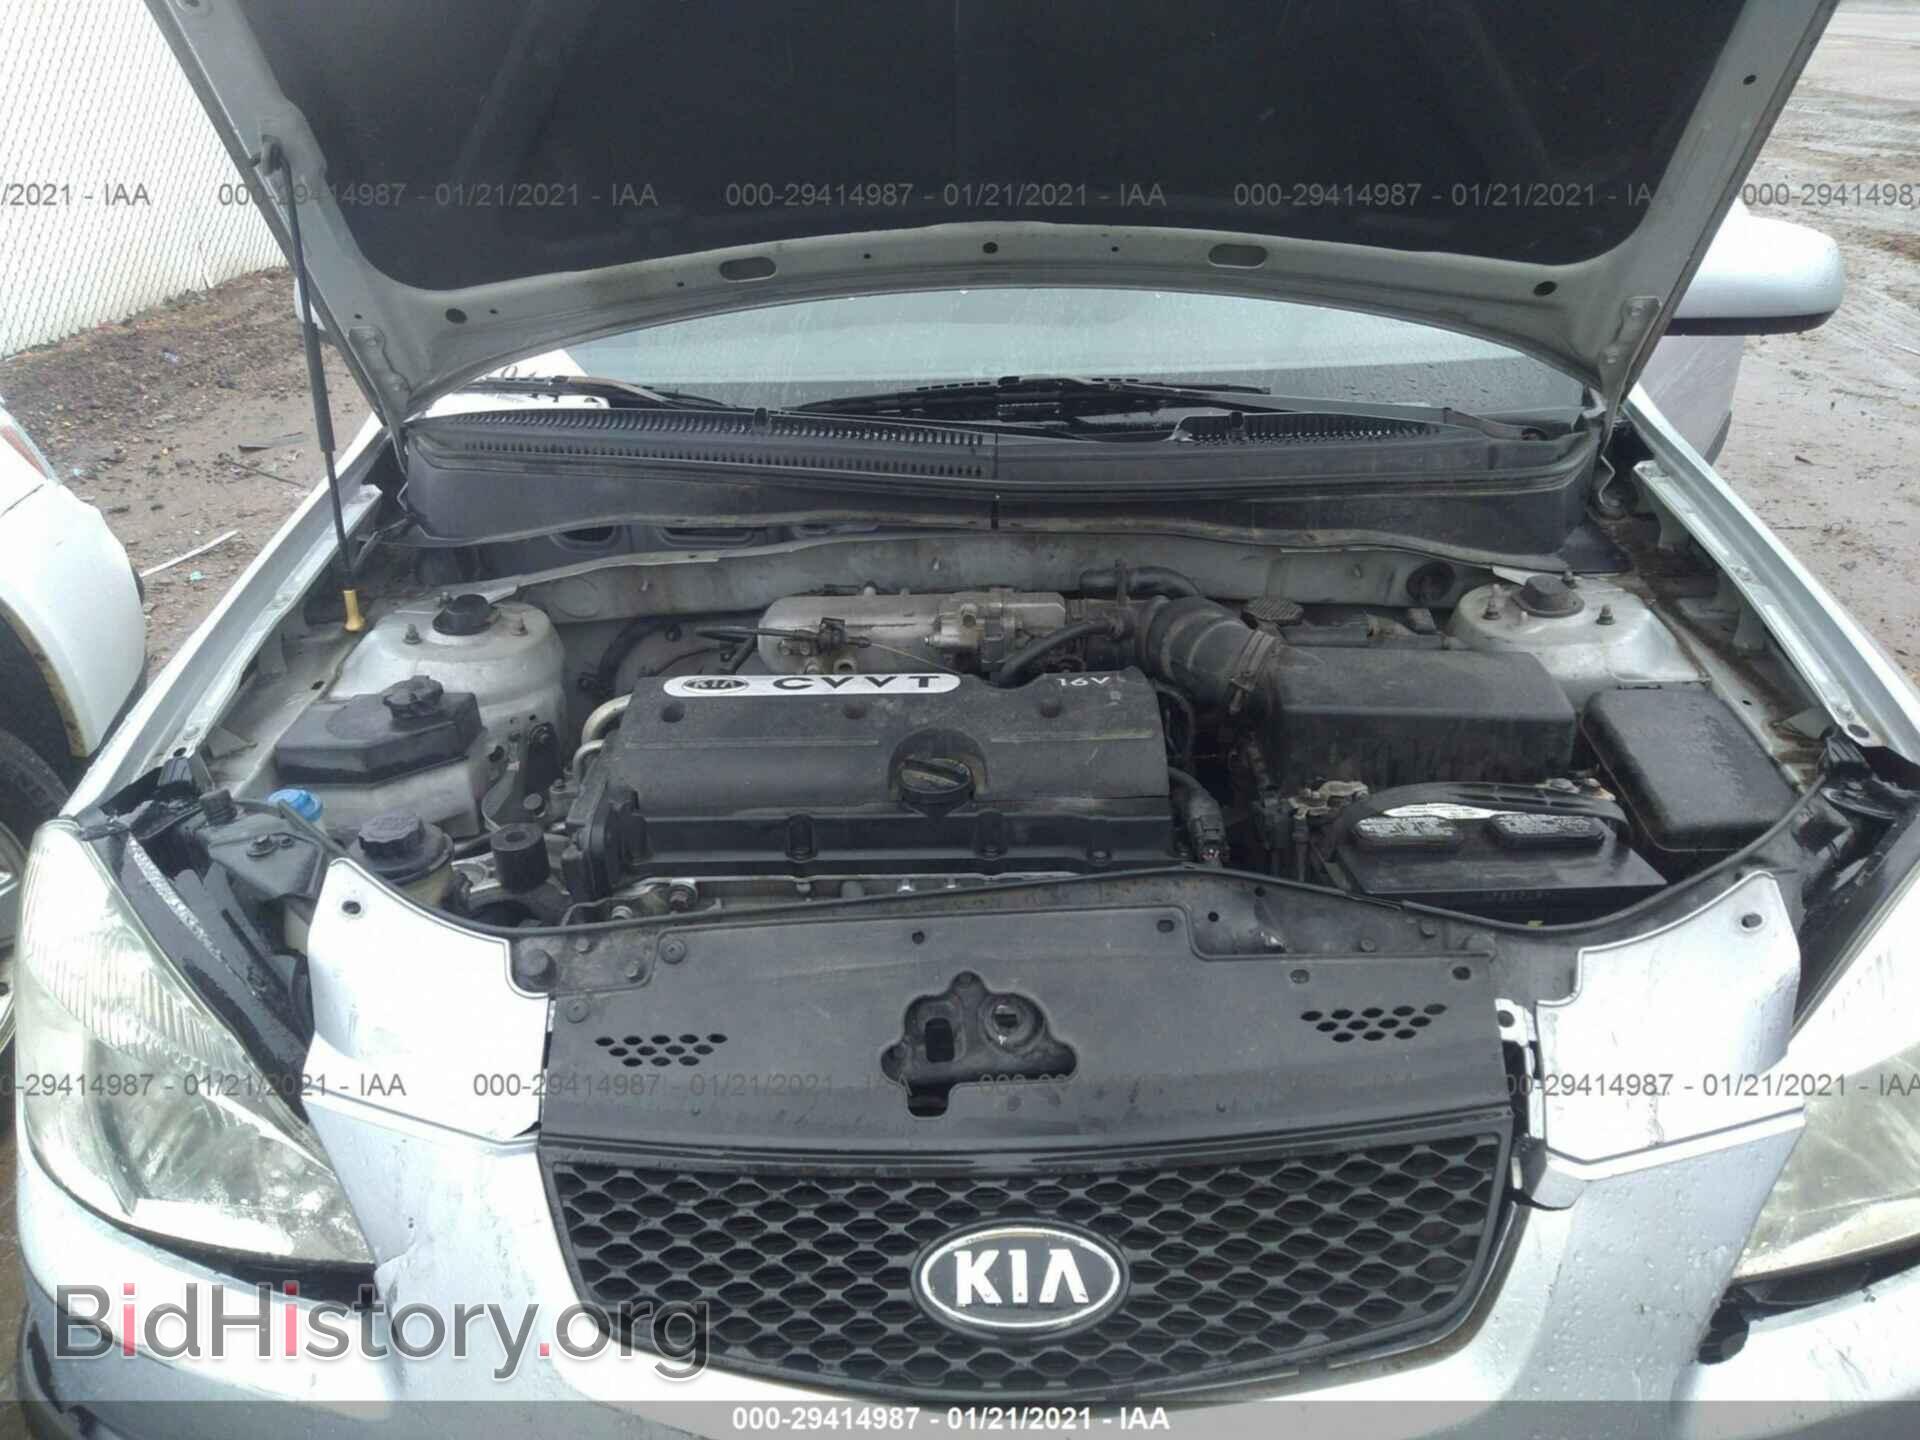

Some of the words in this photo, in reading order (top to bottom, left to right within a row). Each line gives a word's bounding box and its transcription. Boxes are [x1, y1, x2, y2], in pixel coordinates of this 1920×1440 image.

[772, 675, 940, 691] CVVT
[1056, 676, 1110, 687] 16V
[954, 1248, 1090, 1307] KIA
